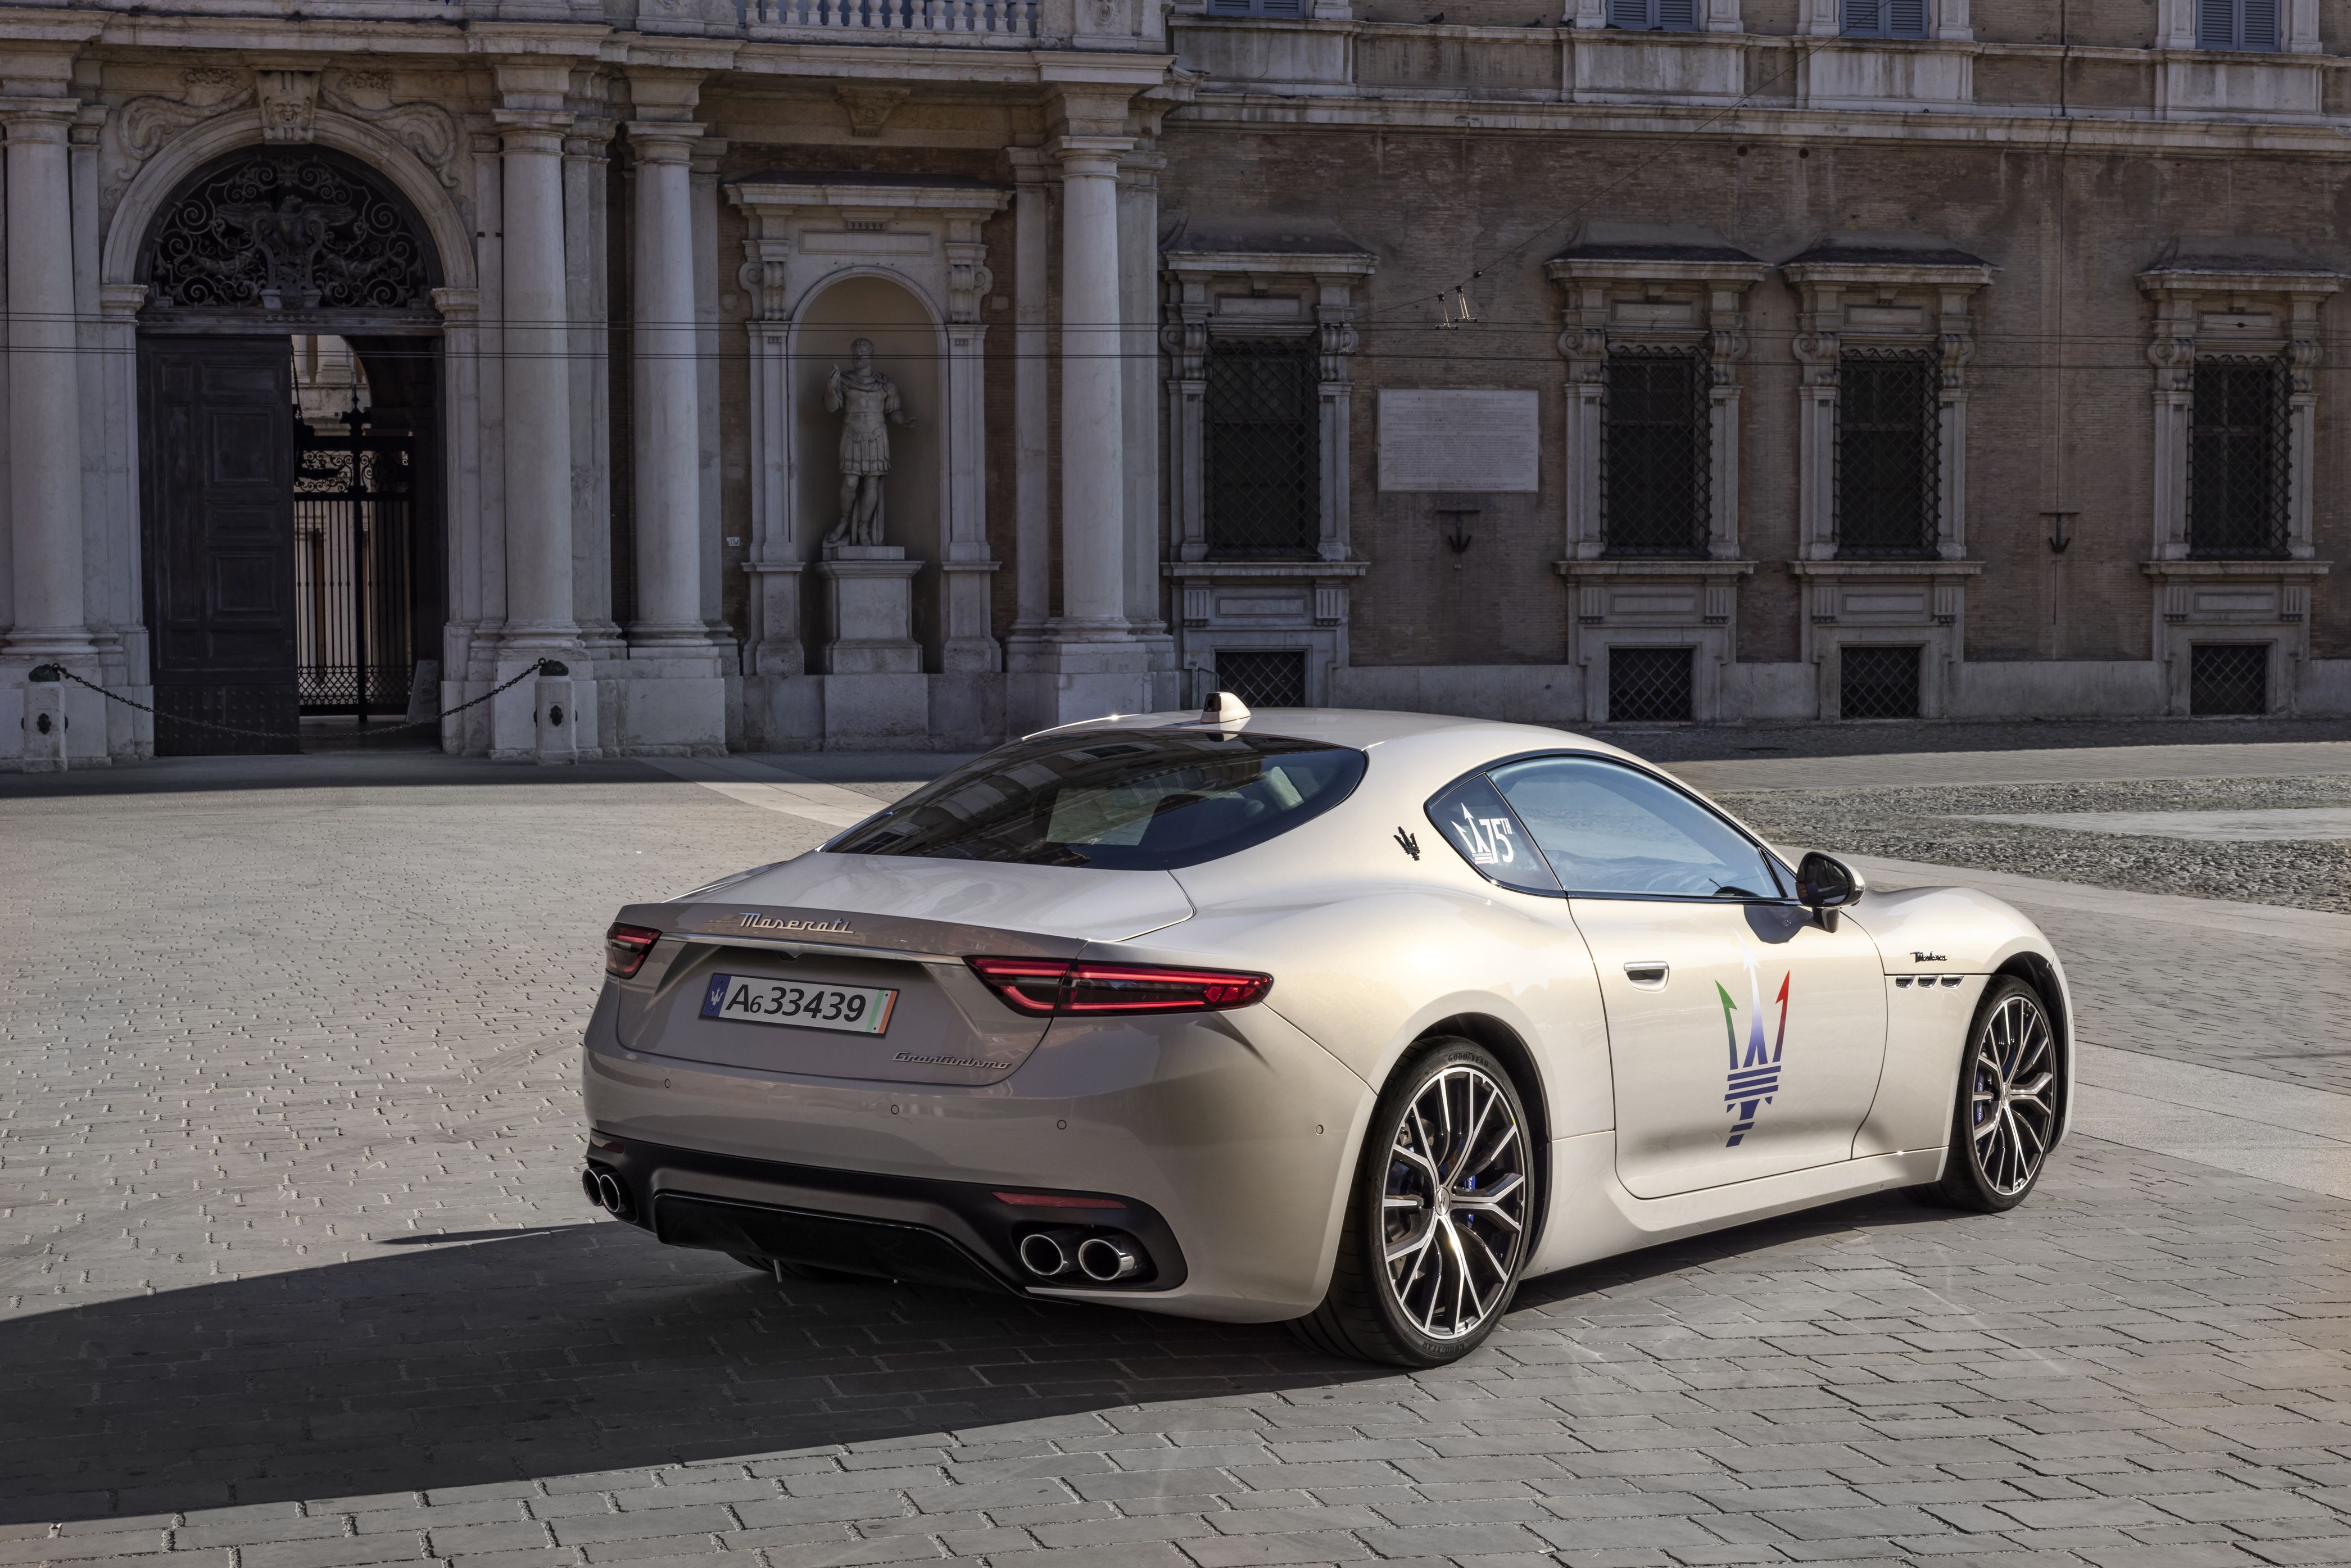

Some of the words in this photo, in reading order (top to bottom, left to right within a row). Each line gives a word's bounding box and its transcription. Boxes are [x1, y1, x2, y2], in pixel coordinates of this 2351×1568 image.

[739, 912, 855, 934] Maserati
[893, 1052, 1012, 1069] GranTurismo
[1448, 1053, 1489, 1068] GOODYEAR
[1421, 1341, 1465, 1354] GOODYEAR
